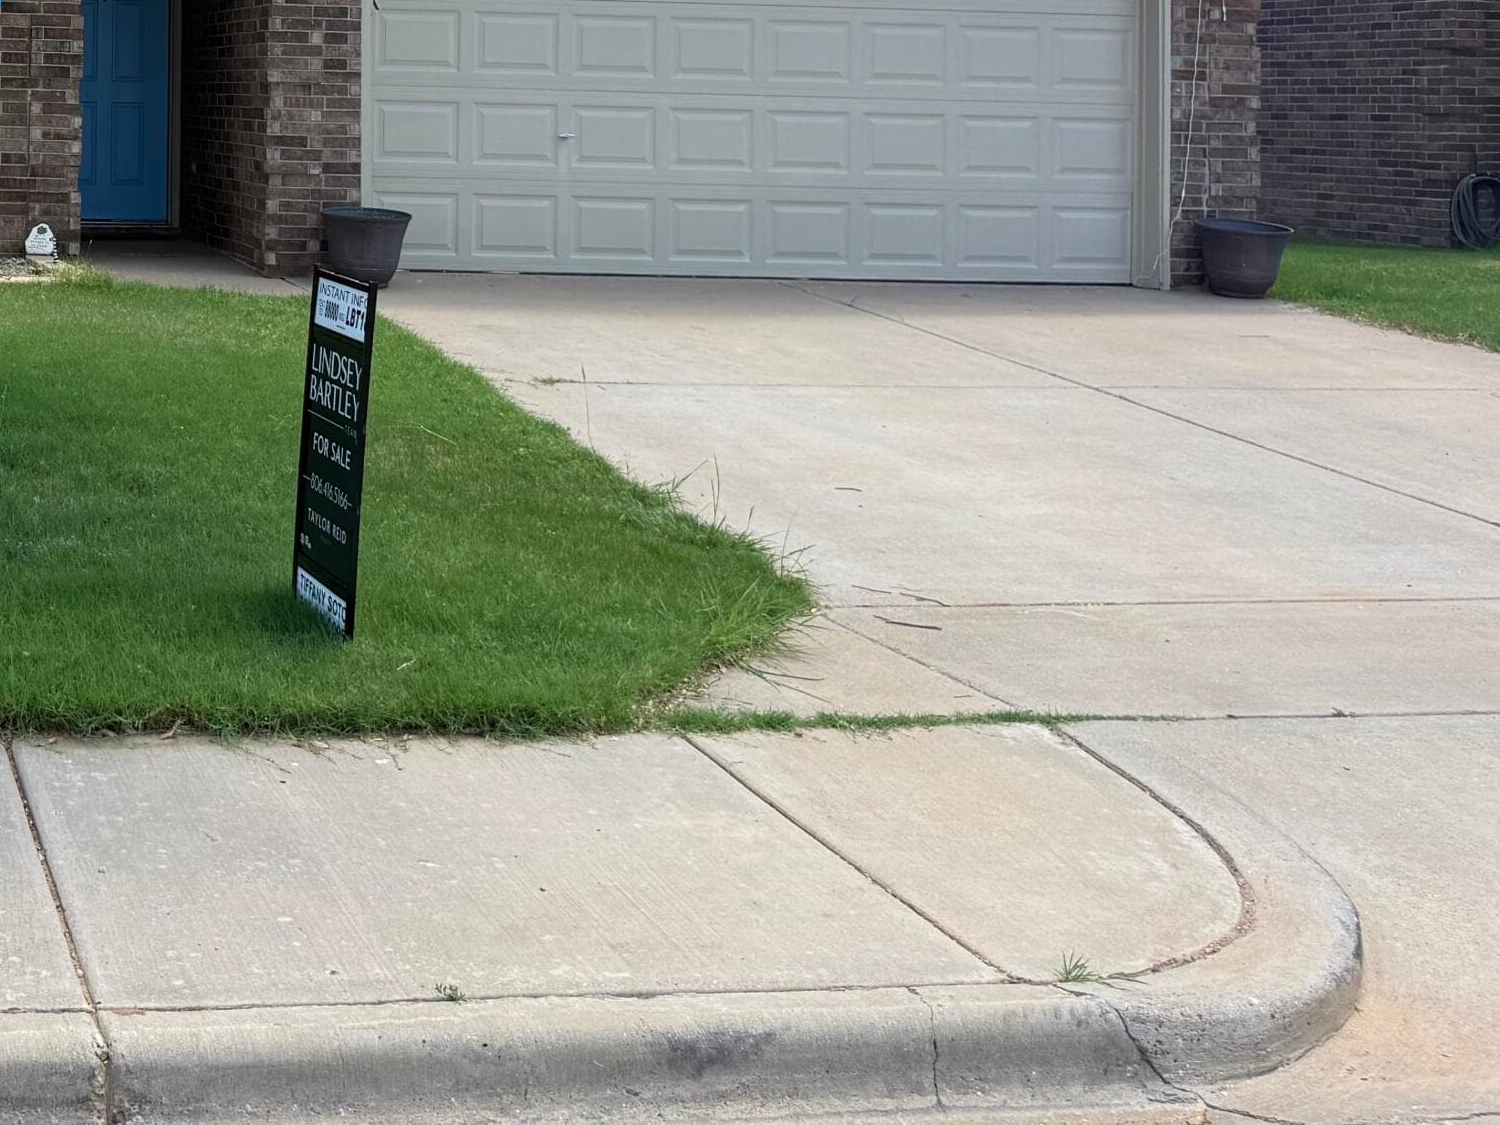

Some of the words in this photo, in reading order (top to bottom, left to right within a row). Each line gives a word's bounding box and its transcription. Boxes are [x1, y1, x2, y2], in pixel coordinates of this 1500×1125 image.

[320, 283, 350, 303] INSTANT
[345, 306, 365, 331] LBT1
[312, 344, 362, 390] LINDSEY
[309, 374, 360, 422] BARTLEY
[312, 432, 329, 458] FOR
[331, 442, 351, 470] SALE
[308, 507, 330, 534] TAYLOR
[332, 523, 347, 544] REID
[300, 573, 326, 606] TIFFANY
